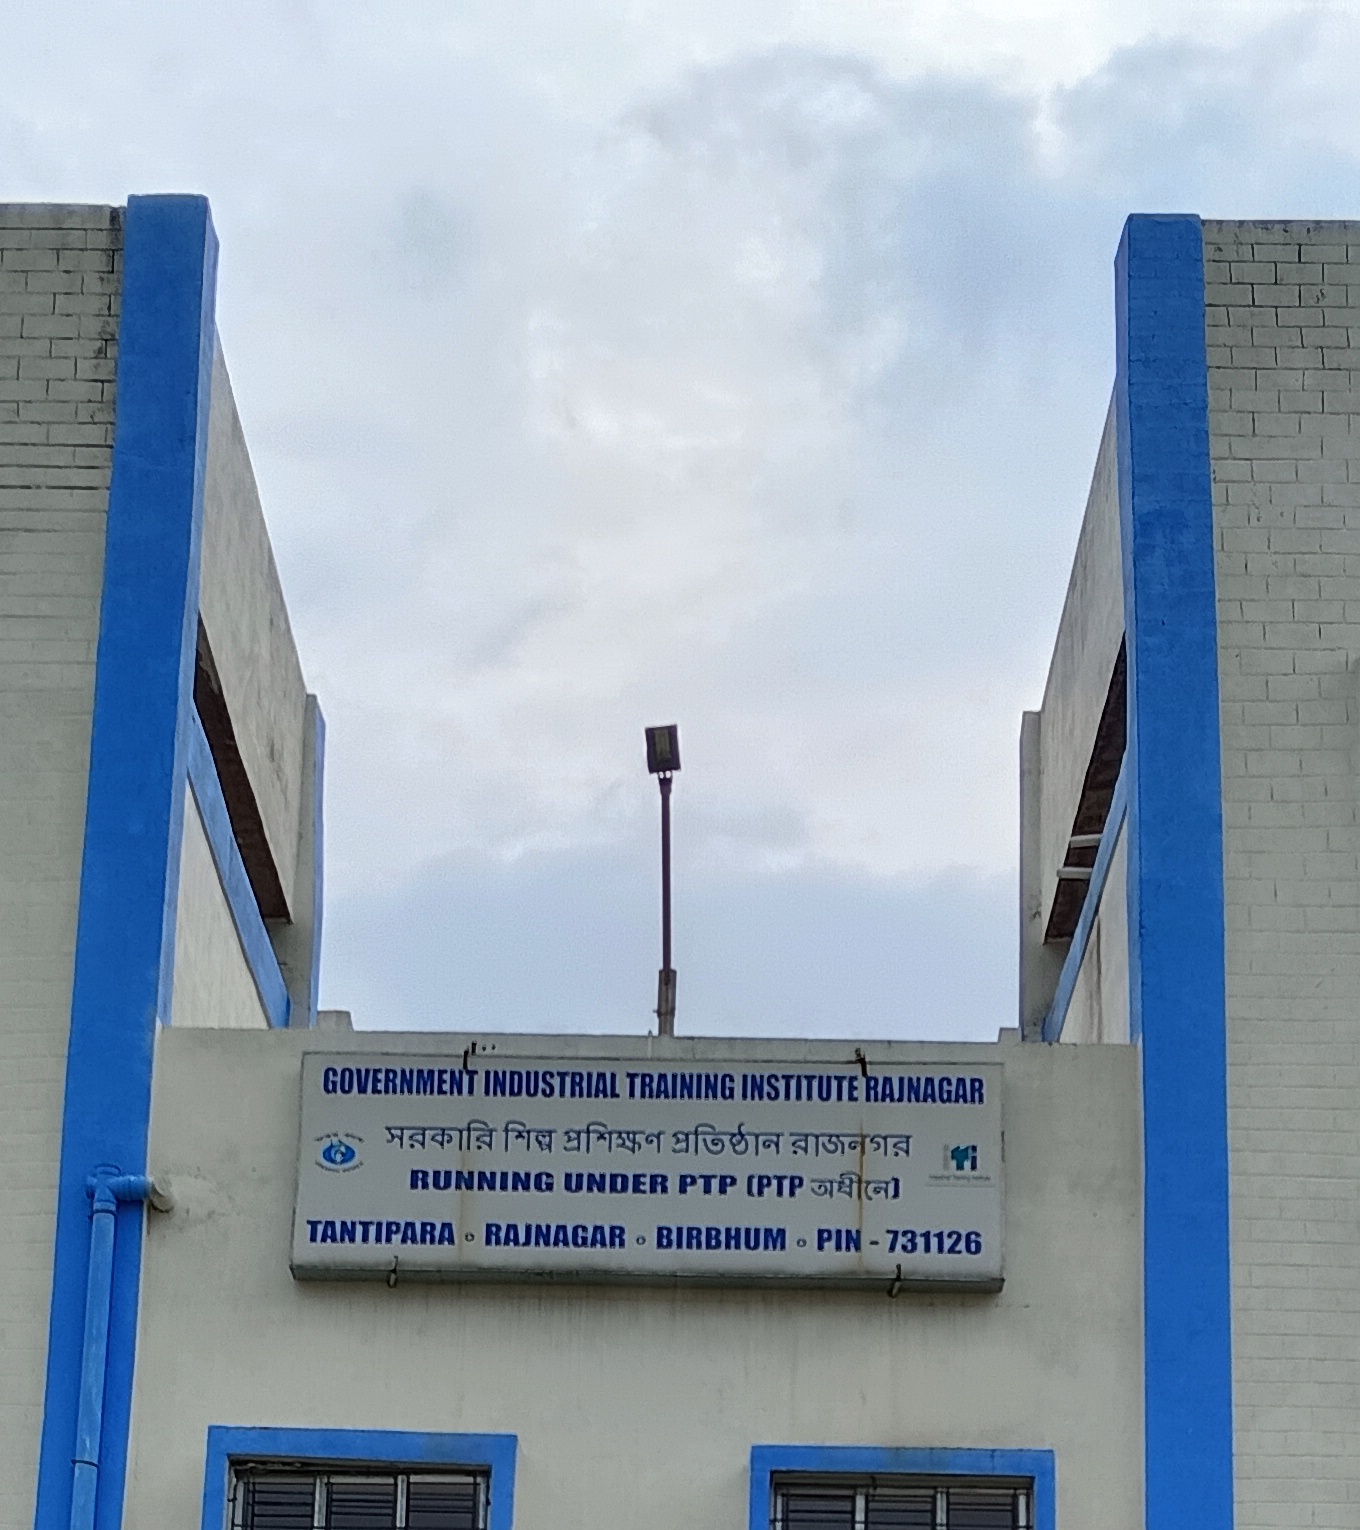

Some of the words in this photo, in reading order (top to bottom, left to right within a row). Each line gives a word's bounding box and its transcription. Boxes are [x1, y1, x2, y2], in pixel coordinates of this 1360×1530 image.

[323, 1066, 478, 1098] GOVERNMENT
[484, 1069, 620, 1099] INDUSTRIAL
[626, 1070, 735, 1101] TRAINING
[741, 1074, 859, 1102] INSTITUTE
[865, 1076, 985, 1105] RAJNAGAR
[385, 1118, 497, 1152] সরকারি
[503, 1119, 558, 1154] শিল্প
[563, 1120, 665, 1155] প্রশিক্ষণ
[671, 1121, 784, 1157] প্রতিষ্ঠান
[790, 1131, 914, 1158] রাজনগর
[409, 1168, 555, 1194] RUNNING
[563, 1171, 669, 1195] UNDER
[678, 1174, 738, 1196] PTP
[306, 1219, 456, 1246] TANTIPARA
[484, 1222, 626, 1249] RAJNAGAR
[656, 1225, 788, 1251] BIRBHUM
[816, 1227, 863, 1253] PIN
[885, 1229, 983, 1256] 731126
